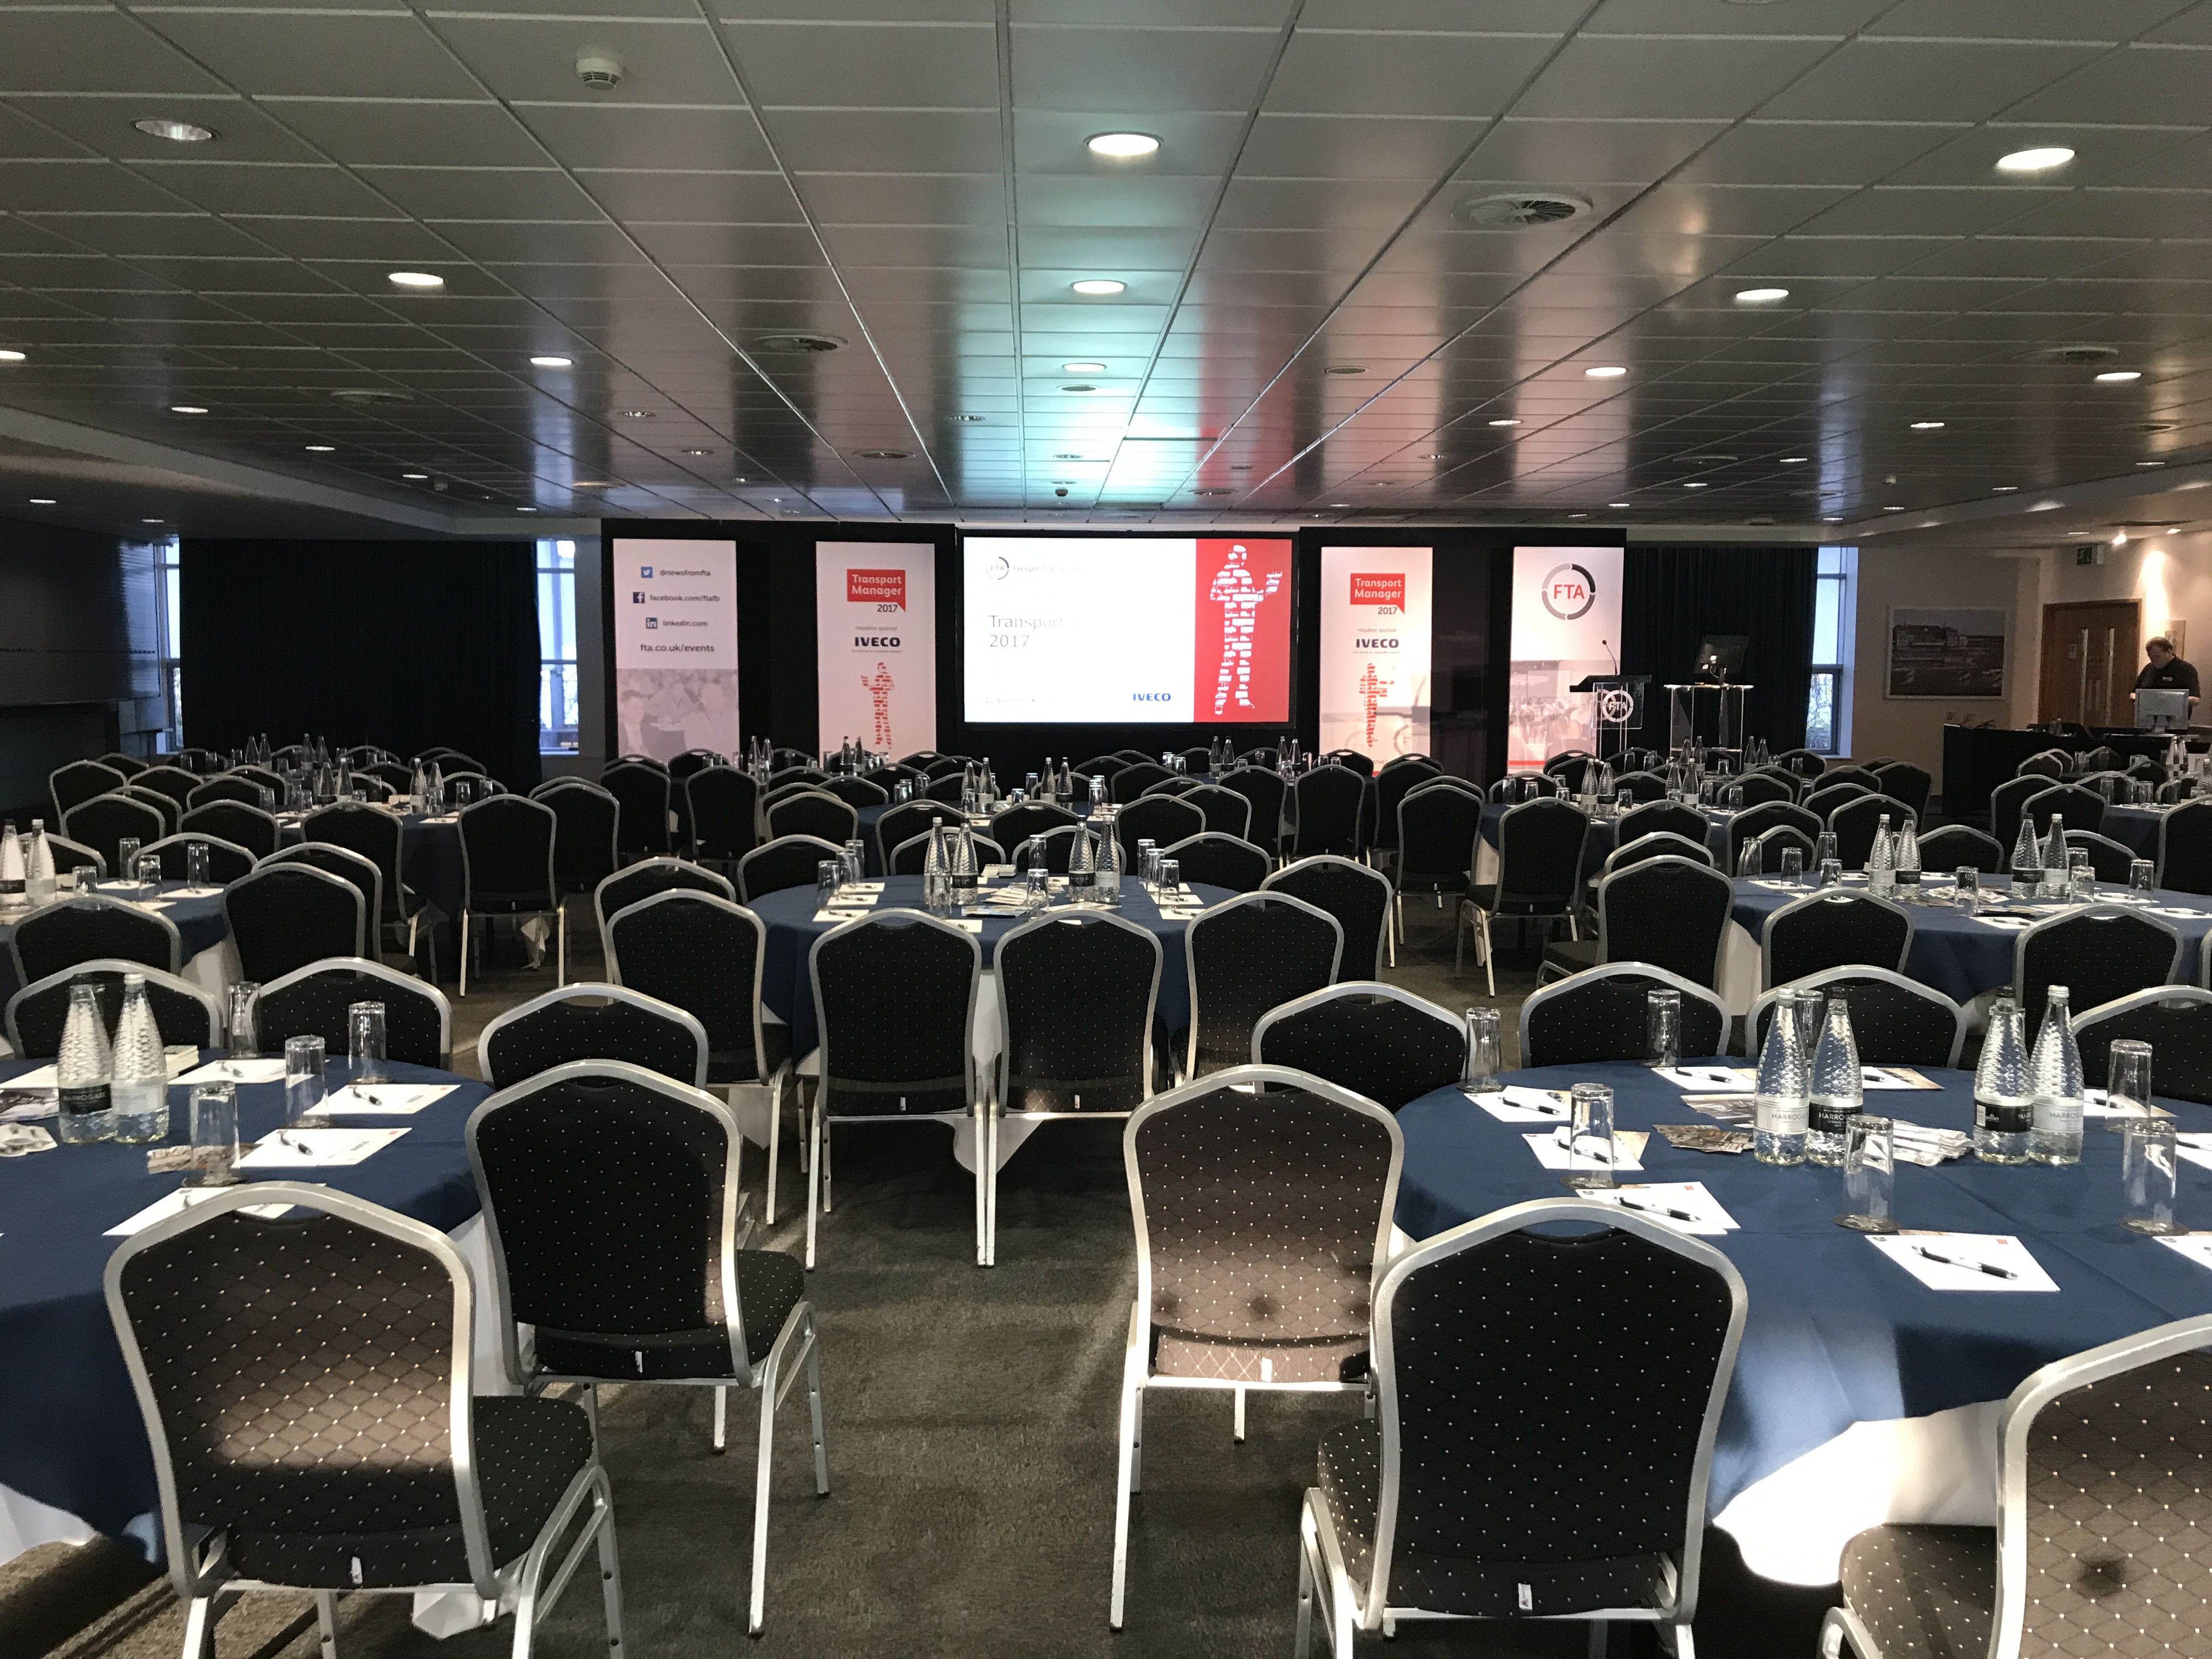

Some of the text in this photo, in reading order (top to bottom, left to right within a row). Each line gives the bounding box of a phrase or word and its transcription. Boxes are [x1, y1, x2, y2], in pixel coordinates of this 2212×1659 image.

[851, 574, 902, 586] Transport
[1355, 578, 1402, 589] Transport
[851, 585, 902, 597] Manager
[1355, 588, 1402, 601] Manager
[1554, 584, 1585, 600] FTA
[877, 603, 898, 613] 2017
[855, 636, 901, 647] IVECO
[990, 634, 1030, 648] 2017
[1356, 638, 1400, 648] IVECO
[640, 644, 715, 652] fta.co.uk/events
[1132, 692, 1172, 702] IVECO
[1609, 701, 1627, 711] FTA
[1771, 1112, 1807, 1120] HARROGA
